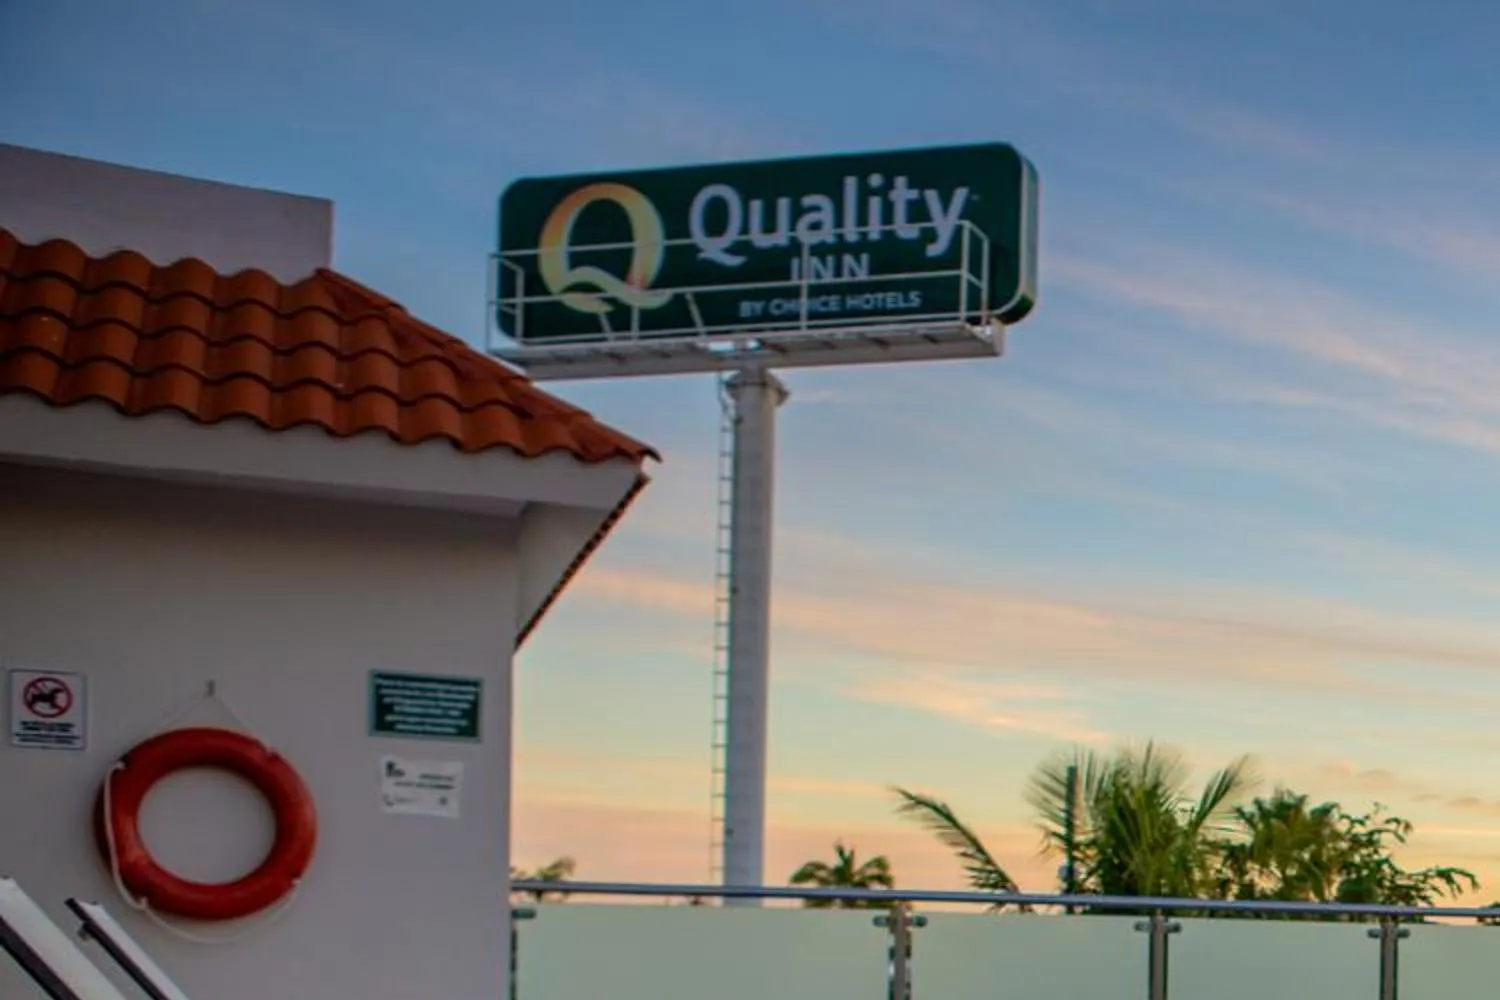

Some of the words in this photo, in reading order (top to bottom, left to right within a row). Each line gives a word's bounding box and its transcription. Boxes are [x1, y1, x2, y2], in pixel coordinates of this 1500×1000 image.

[537, 182, 674, 315] Q
[689, 173, 970, 267] Quality
[790, 253, 870, 281] INN
[739, 301, 763, 319] BY
[845, 290, 922, 312] HOTELS
